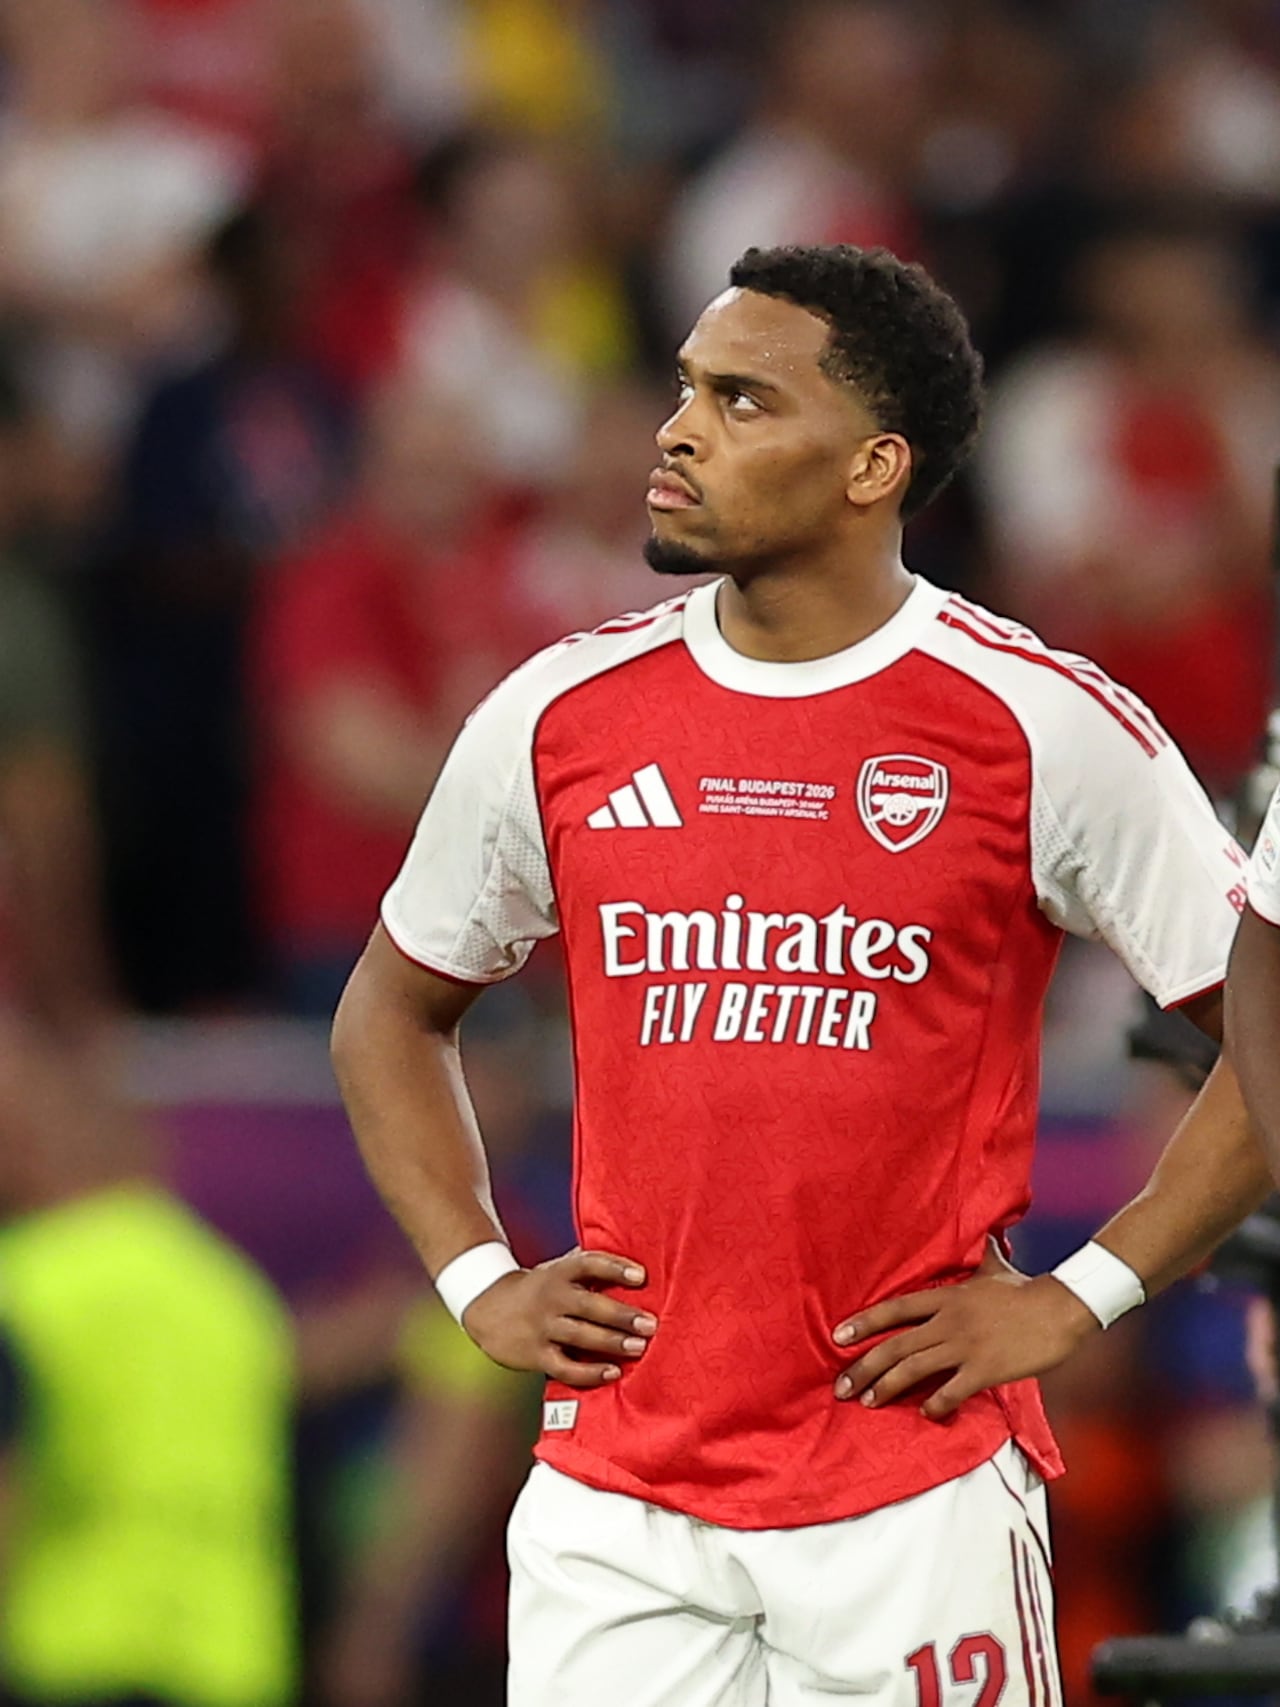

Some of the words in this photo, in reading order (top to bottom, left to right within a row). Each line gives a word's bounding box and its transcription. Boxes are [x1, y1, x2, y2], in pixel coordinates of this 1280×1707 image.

[699, 777, 736, 792] FINAL
[738, 779, 804, 797] BUDAPEST
[804, 783, 836, 800] 2026
[871, 770, 935, 790] Arsenal
[598, 893, 933, 984] Emirates
[640, 982, 708, 1047] FLY
[712, 982, 877, 1051] BETTER
[904, 1629, 1008, 1707] 12
